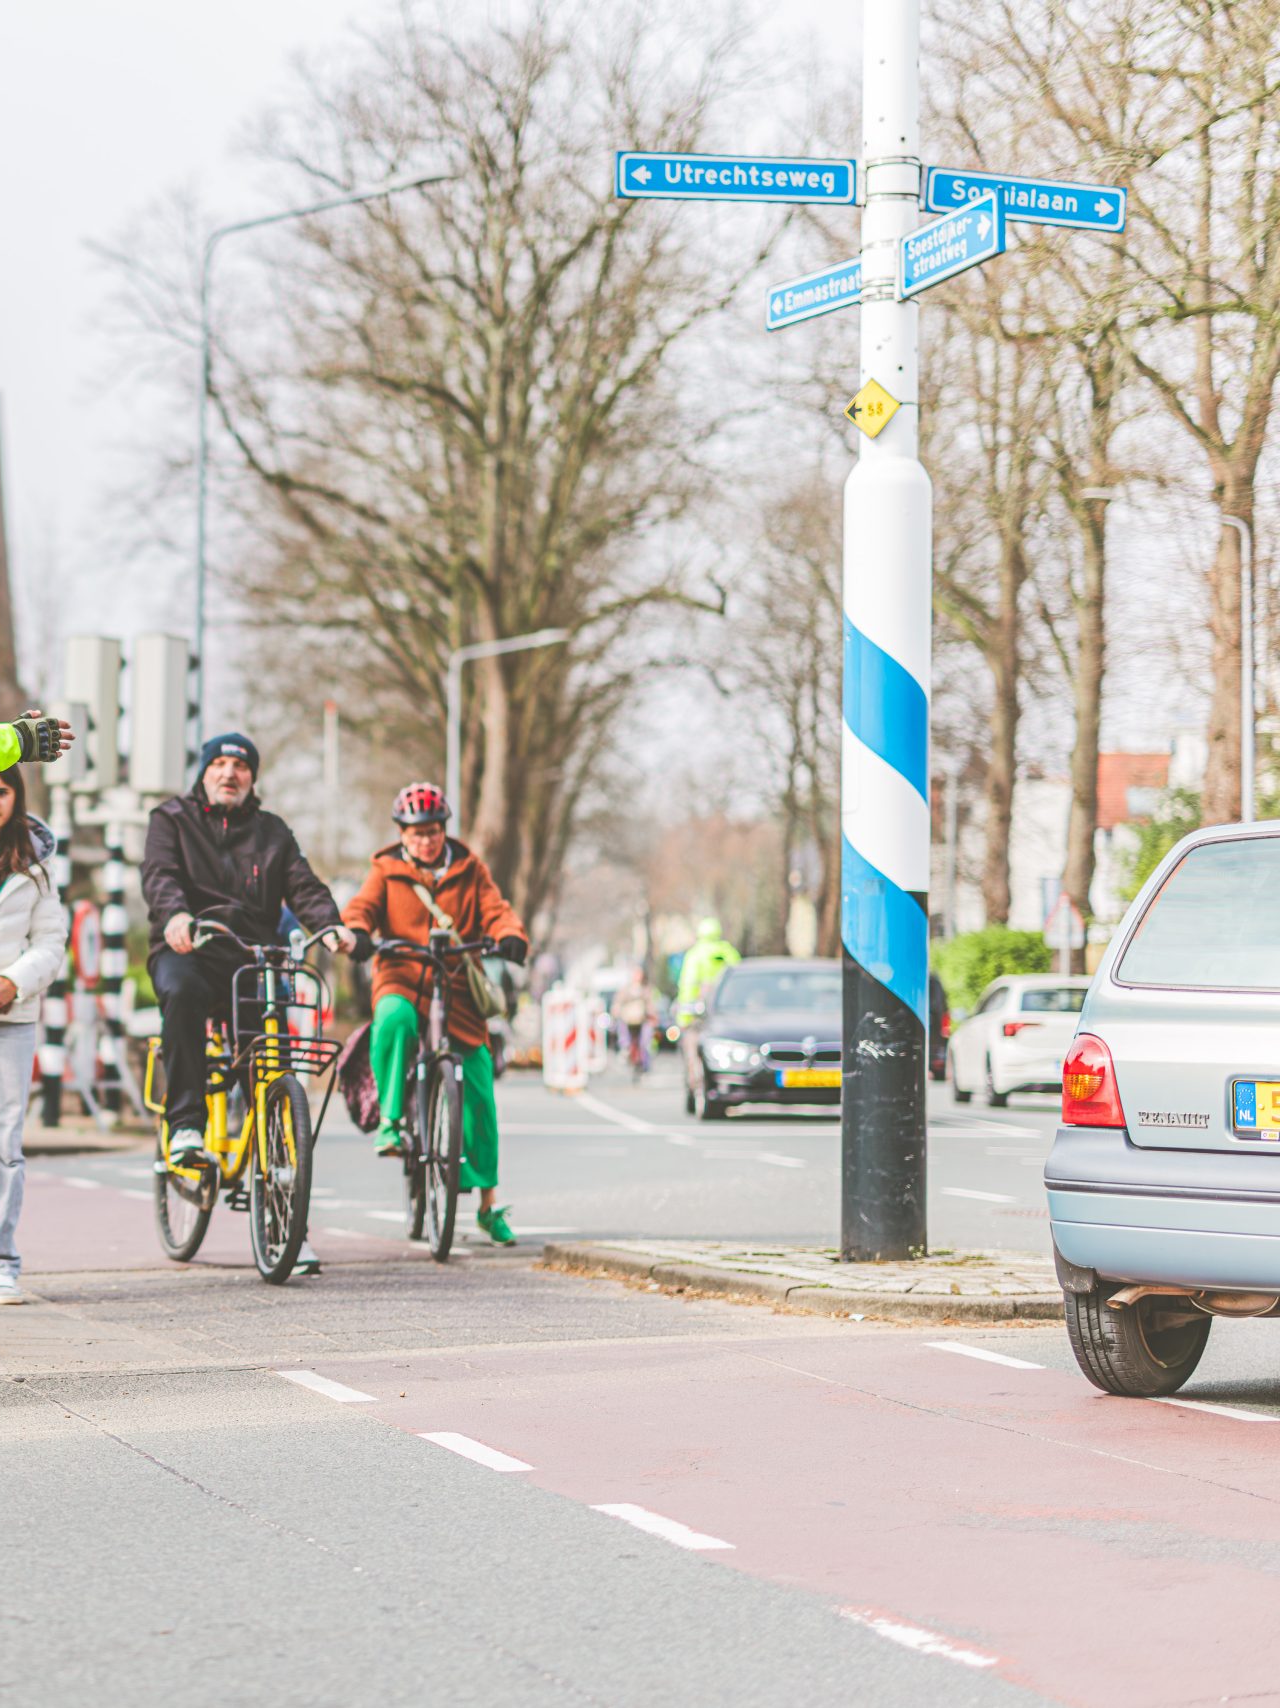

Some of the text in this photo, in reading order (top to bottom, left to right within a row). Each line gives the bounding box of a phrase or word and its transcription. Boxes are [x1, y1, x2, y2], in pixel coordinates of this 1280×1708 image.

[665, 162, 835, 194] Utrechtseweg
[913, 239, 967, 278] straatweg
[1138, 1111, 1210, 1128] RENAULT
[1239, 1109, 1255, 1121] NL
